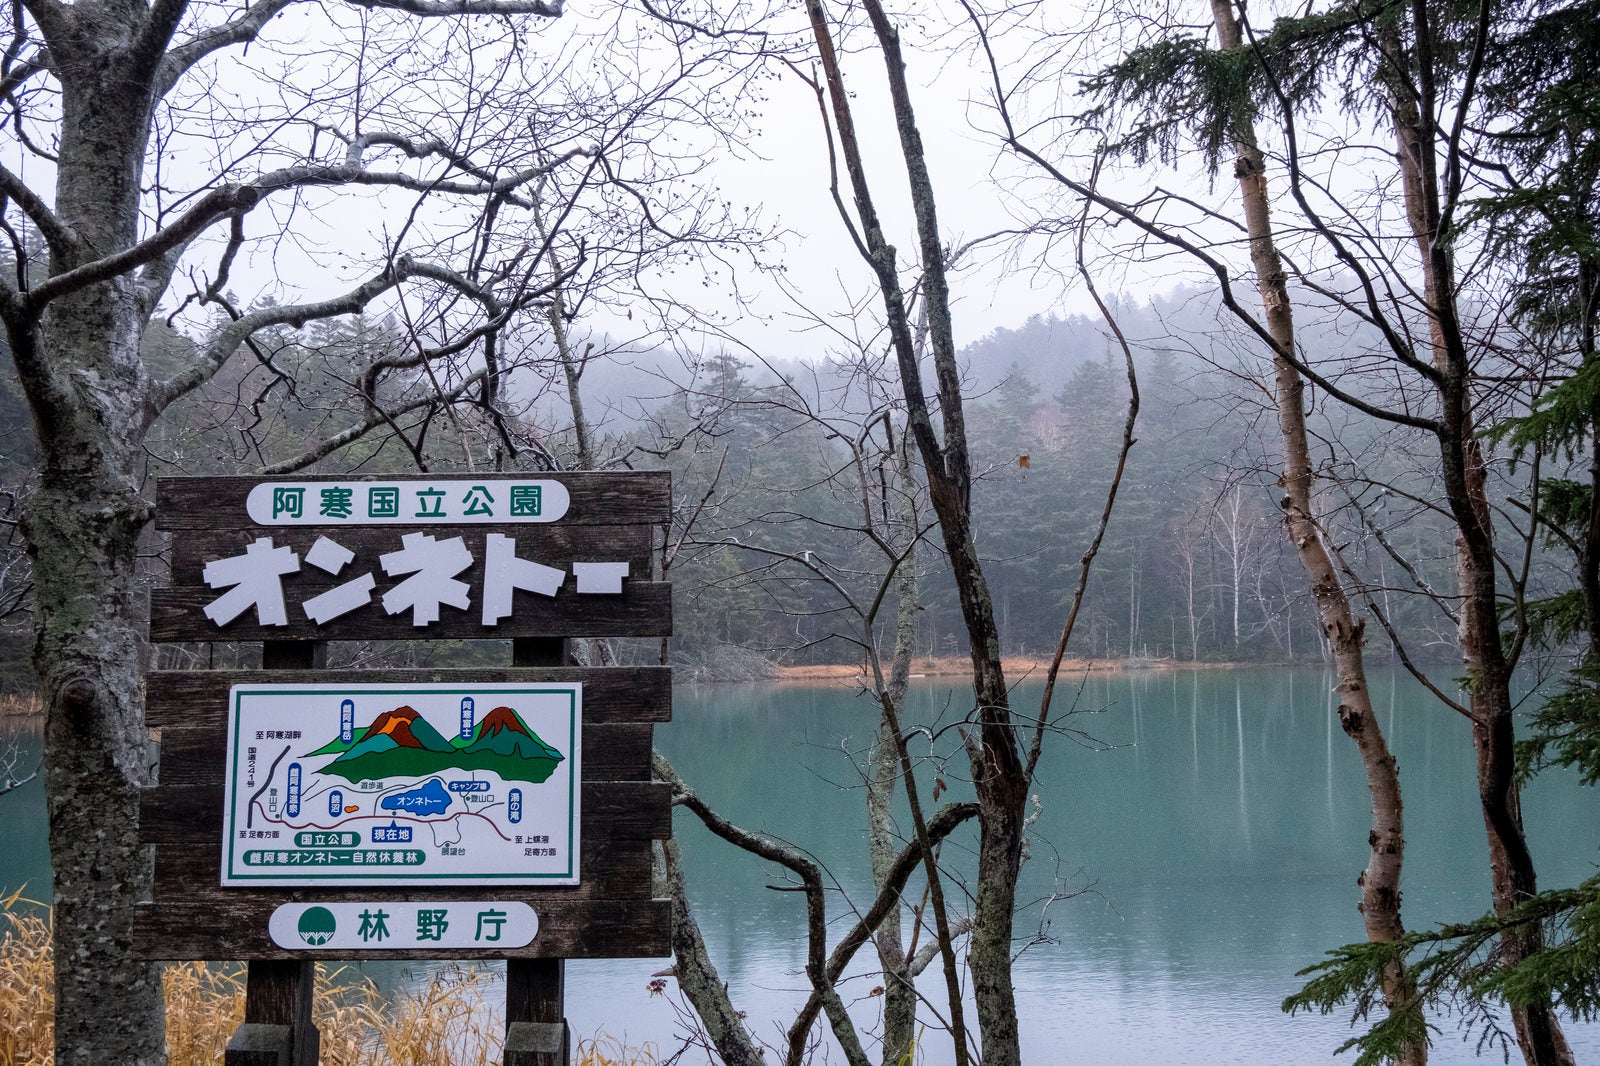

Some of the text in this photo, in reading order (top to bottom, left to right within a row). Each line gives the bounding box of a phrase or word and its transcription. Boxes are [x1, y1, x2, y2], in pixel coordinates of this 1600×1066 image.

[272, 485, 542, 519] 阿寒国立公園
[202, 531, 630, 627] オンネトー
[462, 700, 472, 737] 阿寒富士
[256, 731, 264, 739] 至
[247, 747, 257, 787] 国道241号
[269, 788, 278, 812] 登山口
[397, 797, 442, 806] オンネトー
[471, 795, 494, 803] 登山口
[239, 831, 279, 839] 至 足寄方面
[301, 834, 353, 845] 国立公園
[374, 829, 410, 840] 現在地
[515, 836, 523, 844] 至
[524, 848, 556, 856] 足寄方面
[357, 908, 507, 942] 林野庁
